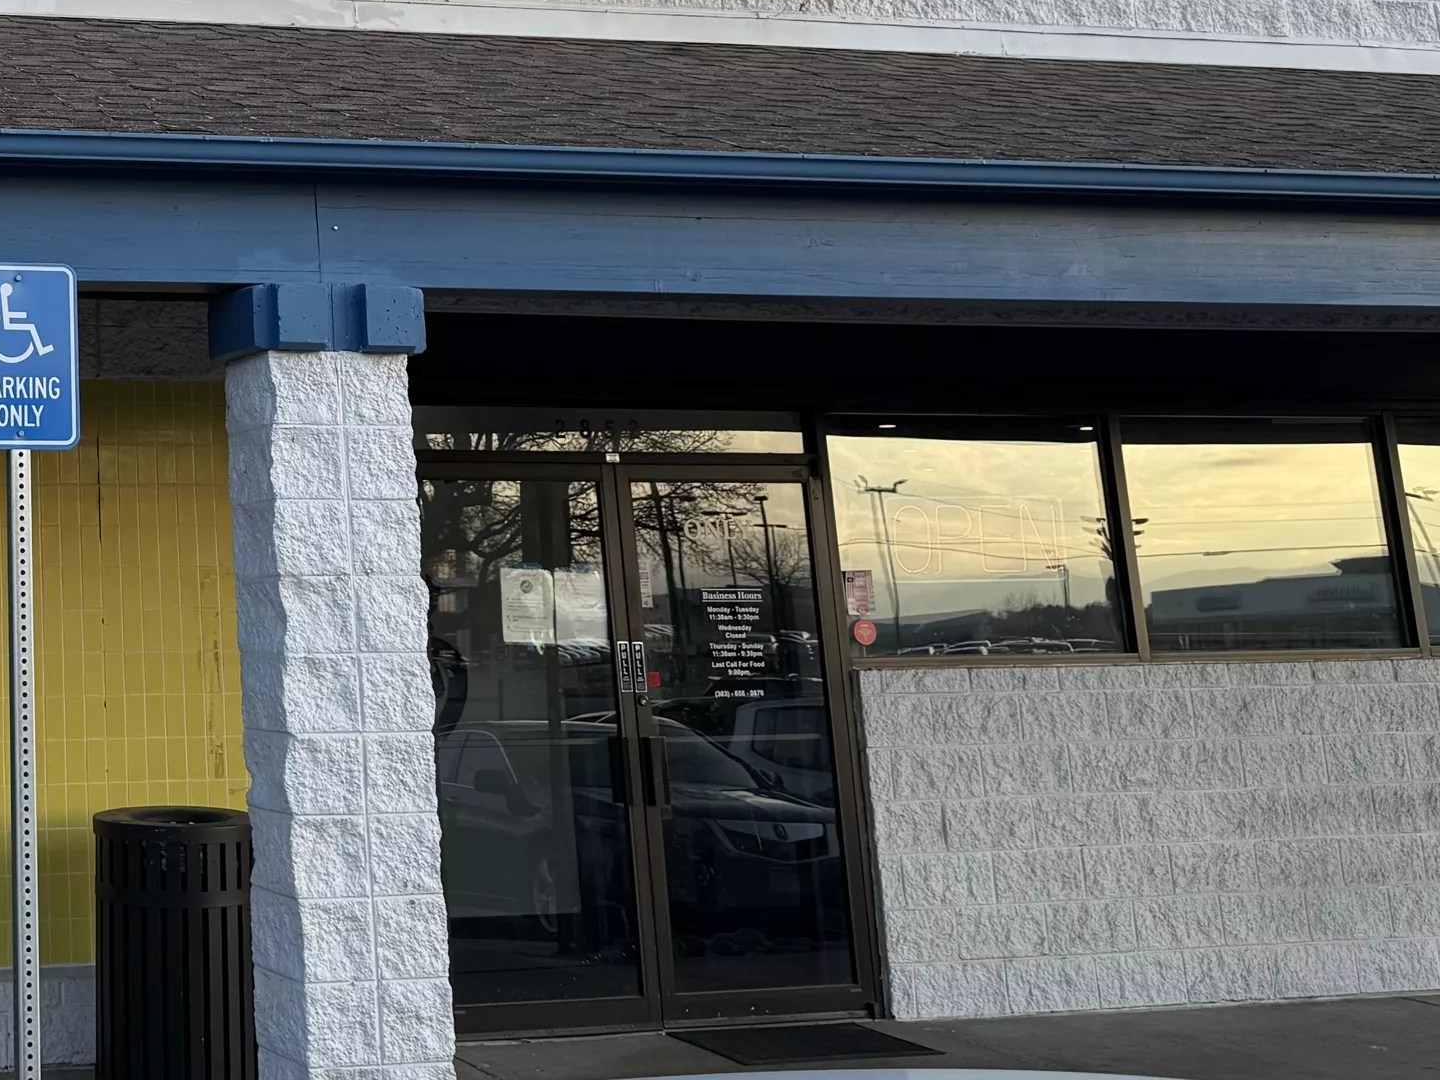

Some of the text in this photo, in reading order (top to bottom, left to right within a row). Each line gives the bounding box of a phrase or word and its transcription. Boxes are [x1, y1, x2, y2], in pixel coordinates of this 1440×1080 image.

[554, 418, 640, 439] 2852
[892, 504, 1064, 575] OPEN
[702, 591, 763, 600] Business Hours
[707, 606, 731, 614] Monday
[734, 605, 760, 614] Tuesday
[717, 624, 752, 632] Wednesday
[709, 642, 737, 651] Thursday
[741, 642, 764, 651] Sunday
